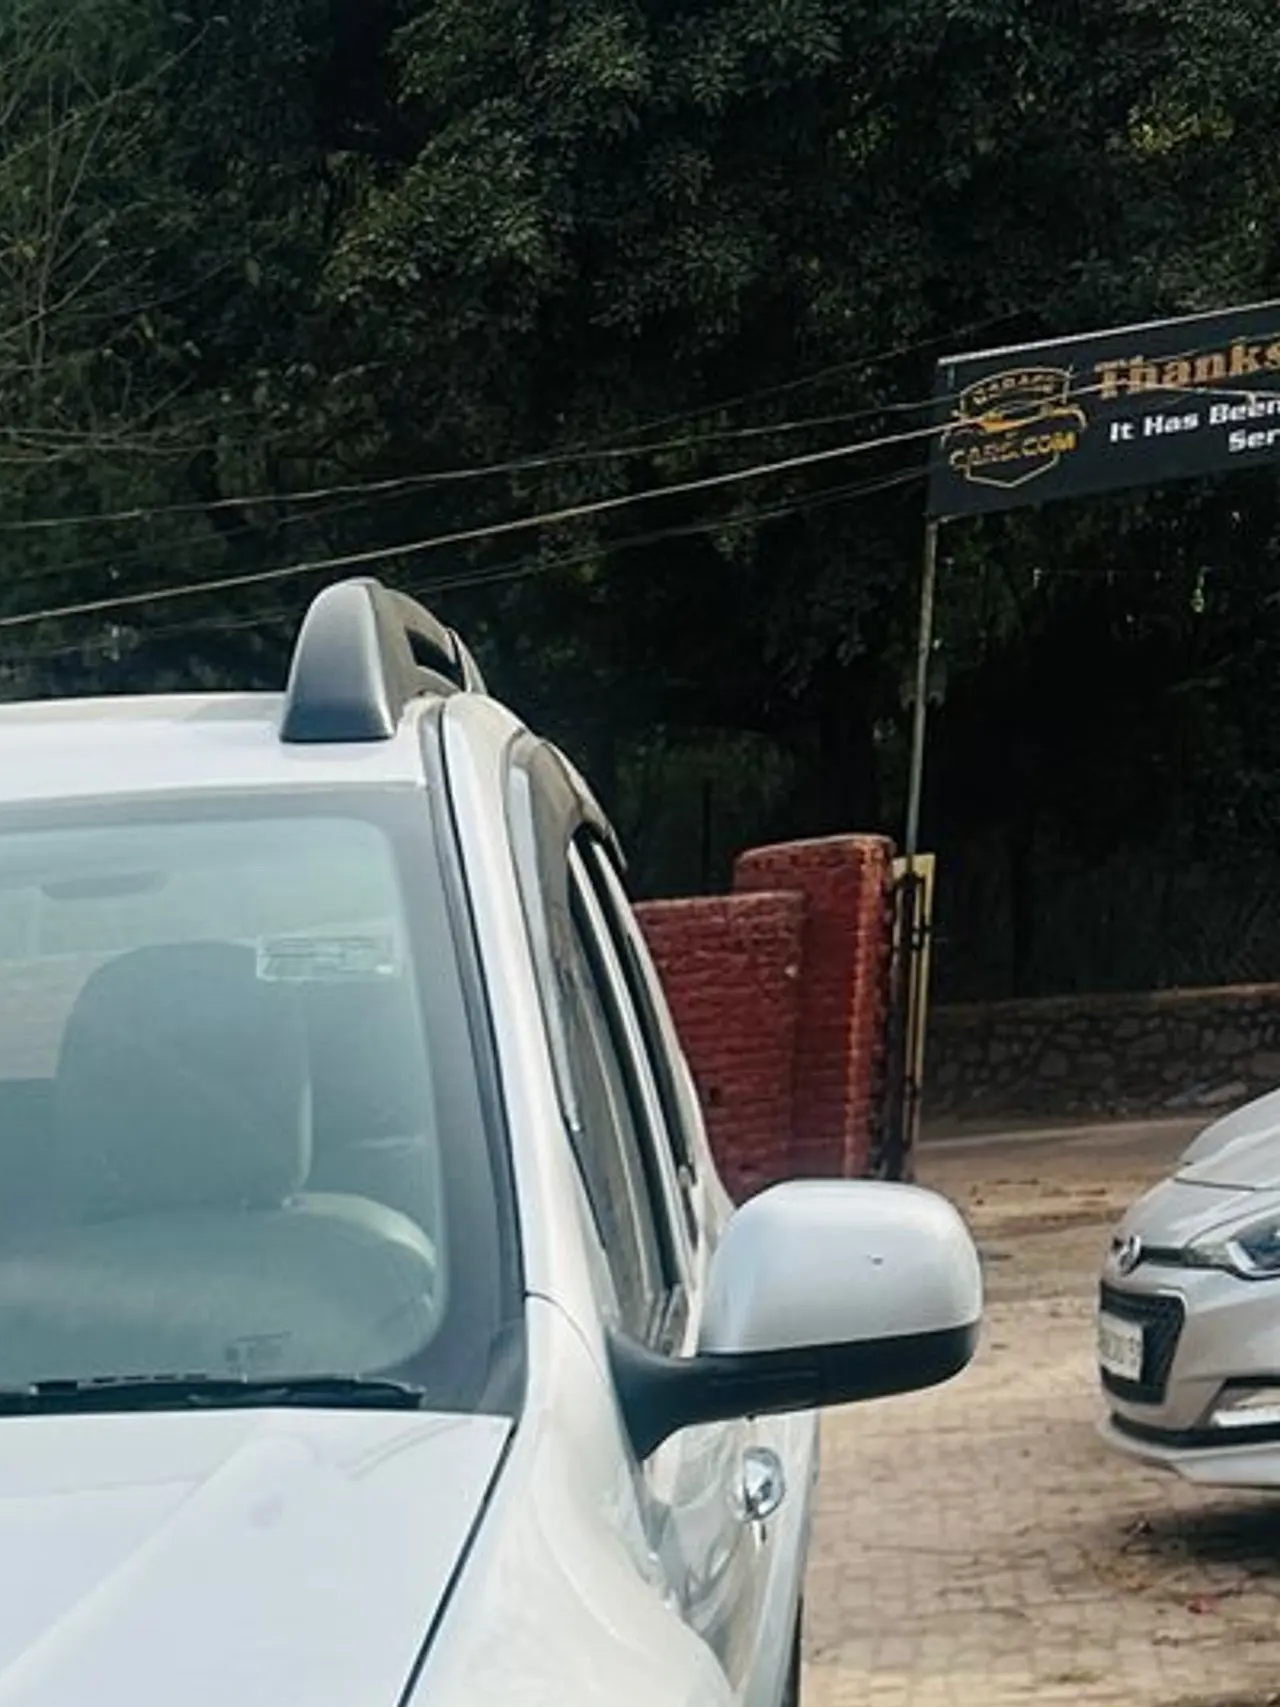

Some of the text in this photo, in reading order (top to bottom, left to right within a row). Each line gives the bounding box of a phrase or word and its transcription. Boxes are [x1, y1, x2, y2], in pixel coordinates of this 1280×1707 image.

[1094, 334, 1280, 399] Thanks
[1109, 398, 1280, 443] It Has Been
